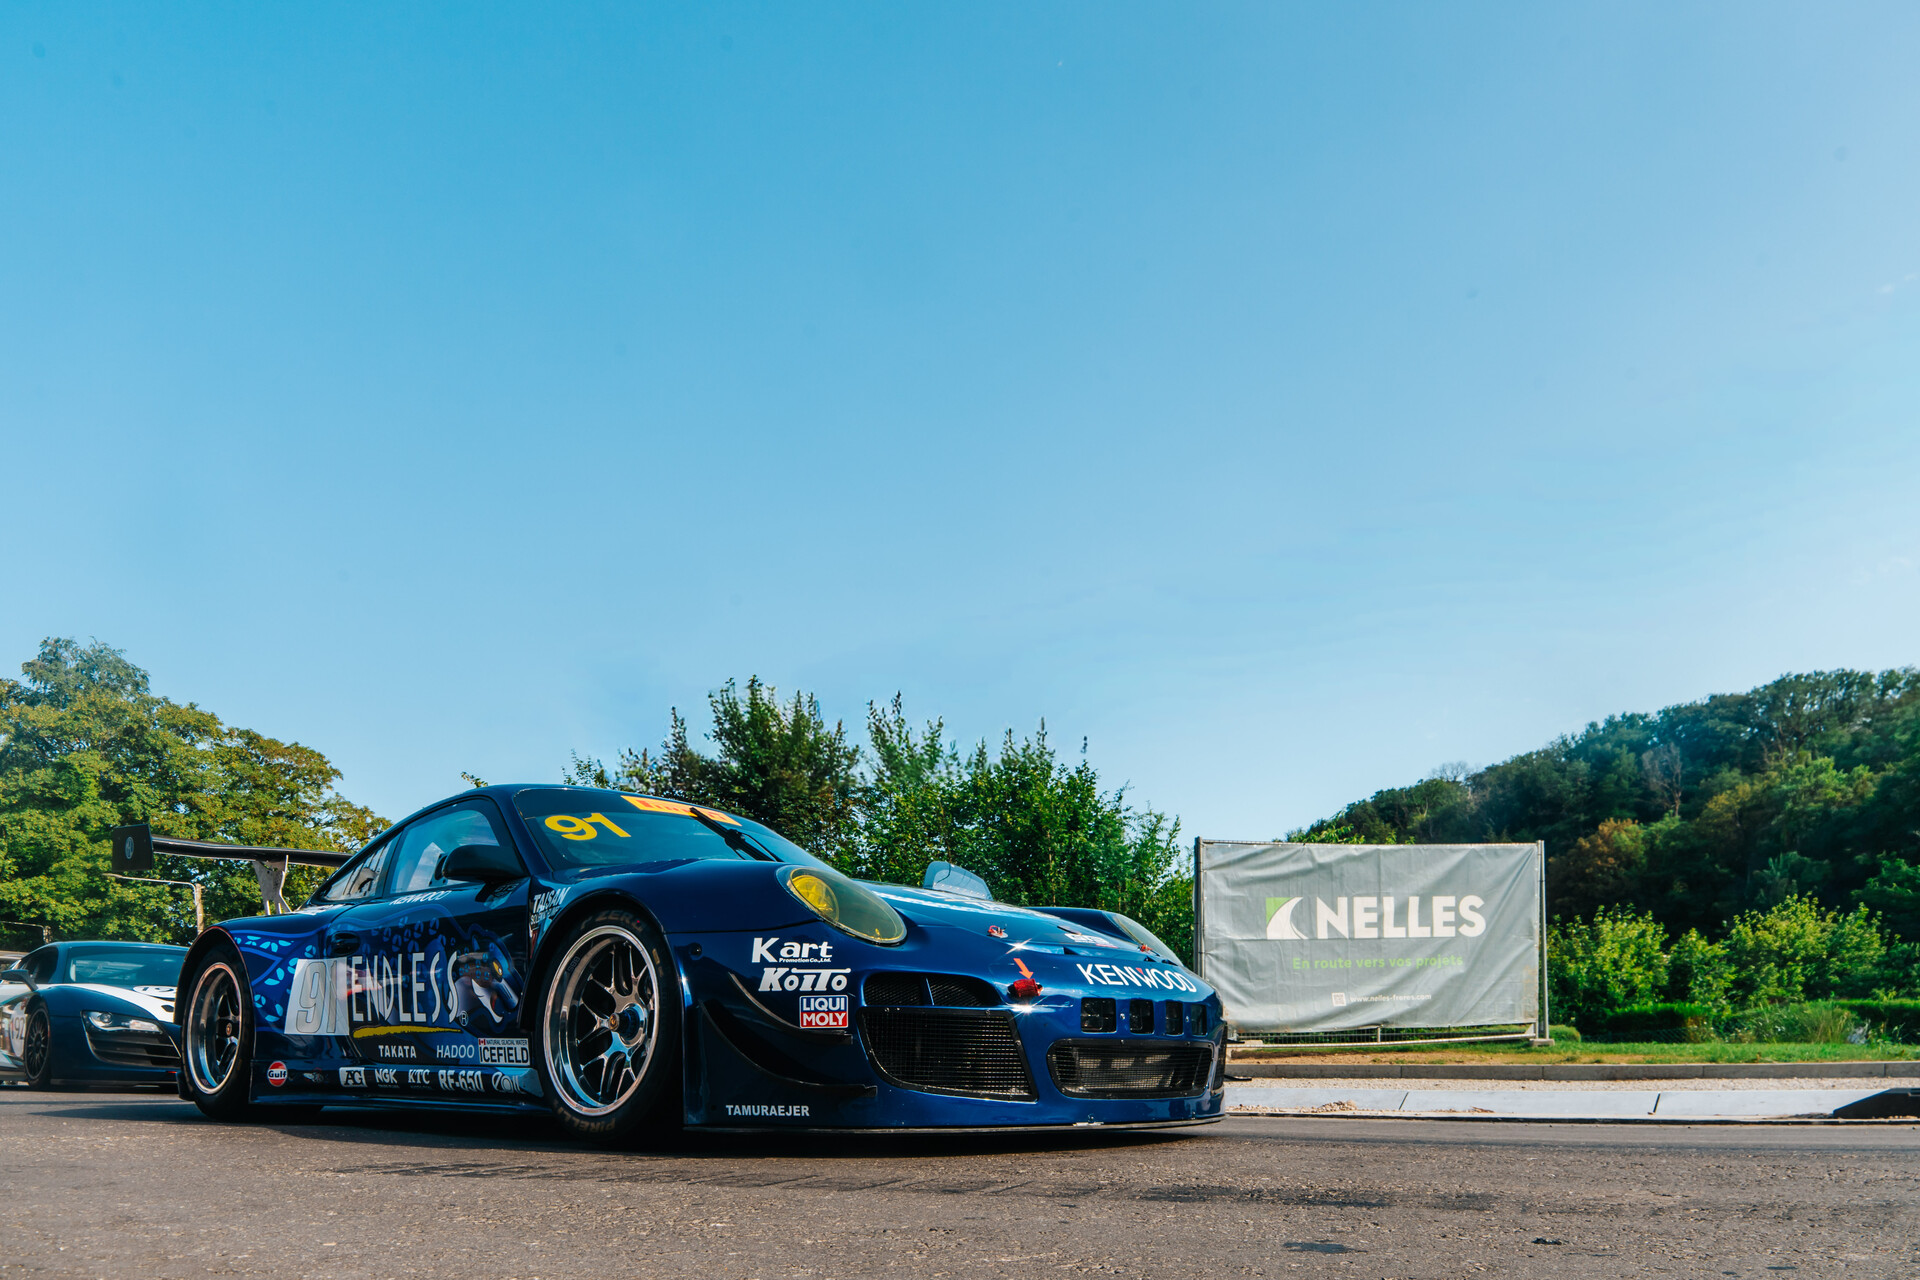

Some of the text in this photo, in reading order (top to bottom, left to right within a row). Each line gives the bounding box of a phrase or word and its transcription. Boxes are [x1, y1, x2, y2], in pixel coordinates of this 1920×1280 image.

[545, 812, 631, 841] 91
[532, 886, 571, 914] TAISAN
[1316, 894, 1487, 939] NELLES
[751, 937, 833, 963] Kart
[1292, 953, 1464, 969] En route vers vos projets
[351, 950, 459, 1023] ENDLESS
[1076, 963, 1197, 993] KENWOOD
[295, 960, 338, 1034] 91
[802, 997, 846, 1011] LIQUI
[802, 1012, 847, 1026] MOLY
[378, 1045, 417, 1058] TAKATA
[436, 1044, 475, 1058] HADOO
[479, 1046, 529, 1064] ICEFIELD
[268, 1070, 287, 1078] Gulf
[374, 1068, 398, 1084] NGK
[408, 1068, 431, 1084] KTC
[438, 1069, 485, 1092] RF-650
[725, 1104, 810, 1117] TAMURAEJER
[556, 1106, 617, 1134] PIRELLI
